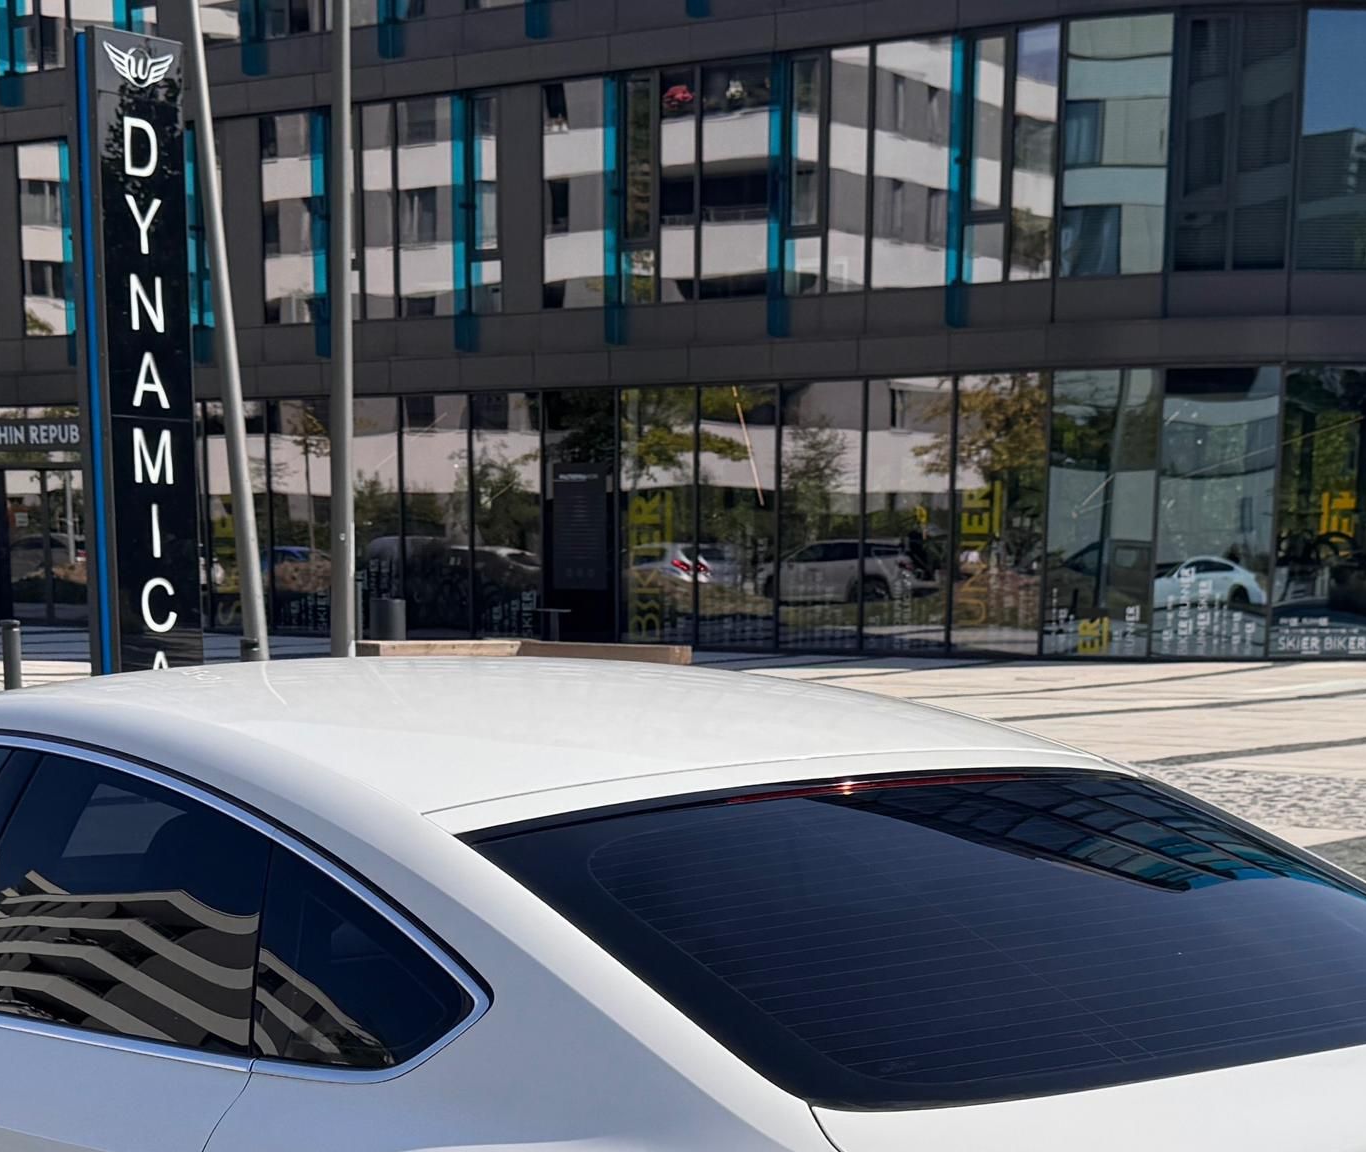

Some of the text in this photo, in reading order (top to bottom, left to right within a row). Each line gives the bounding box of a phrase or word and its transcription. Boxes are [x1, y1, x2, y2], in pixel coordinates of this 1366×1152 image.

[29, 424, 80, 445] REPUB
[957, 481, 989, 626] UNNER
[1277, 636, 1366, 651] SKIER BIKER
